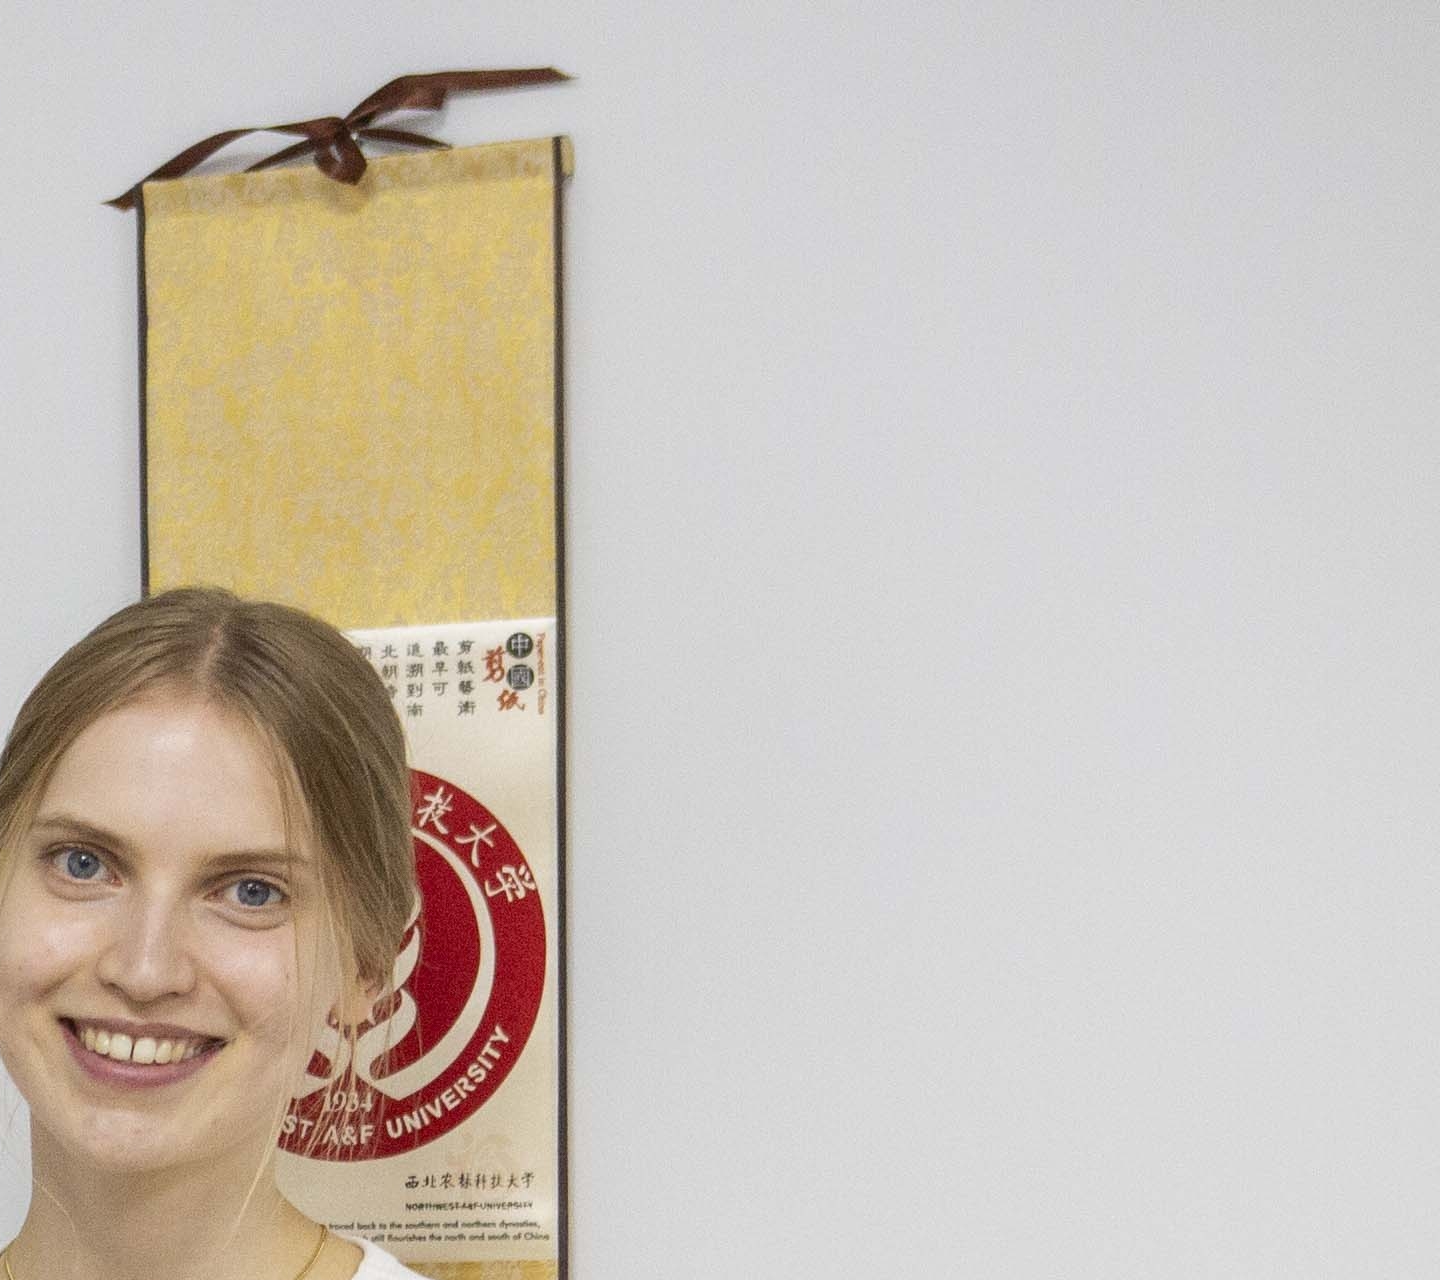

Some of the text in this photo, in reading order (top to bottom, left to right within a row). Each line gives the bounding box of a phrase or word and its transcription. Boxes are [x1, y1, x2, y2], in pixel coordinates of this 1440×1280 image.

[386, 1024, 510, 1140] UNIVERSITY
[442, 1220, 458, 1229] and
[468, 1232, 485, 1241] and
